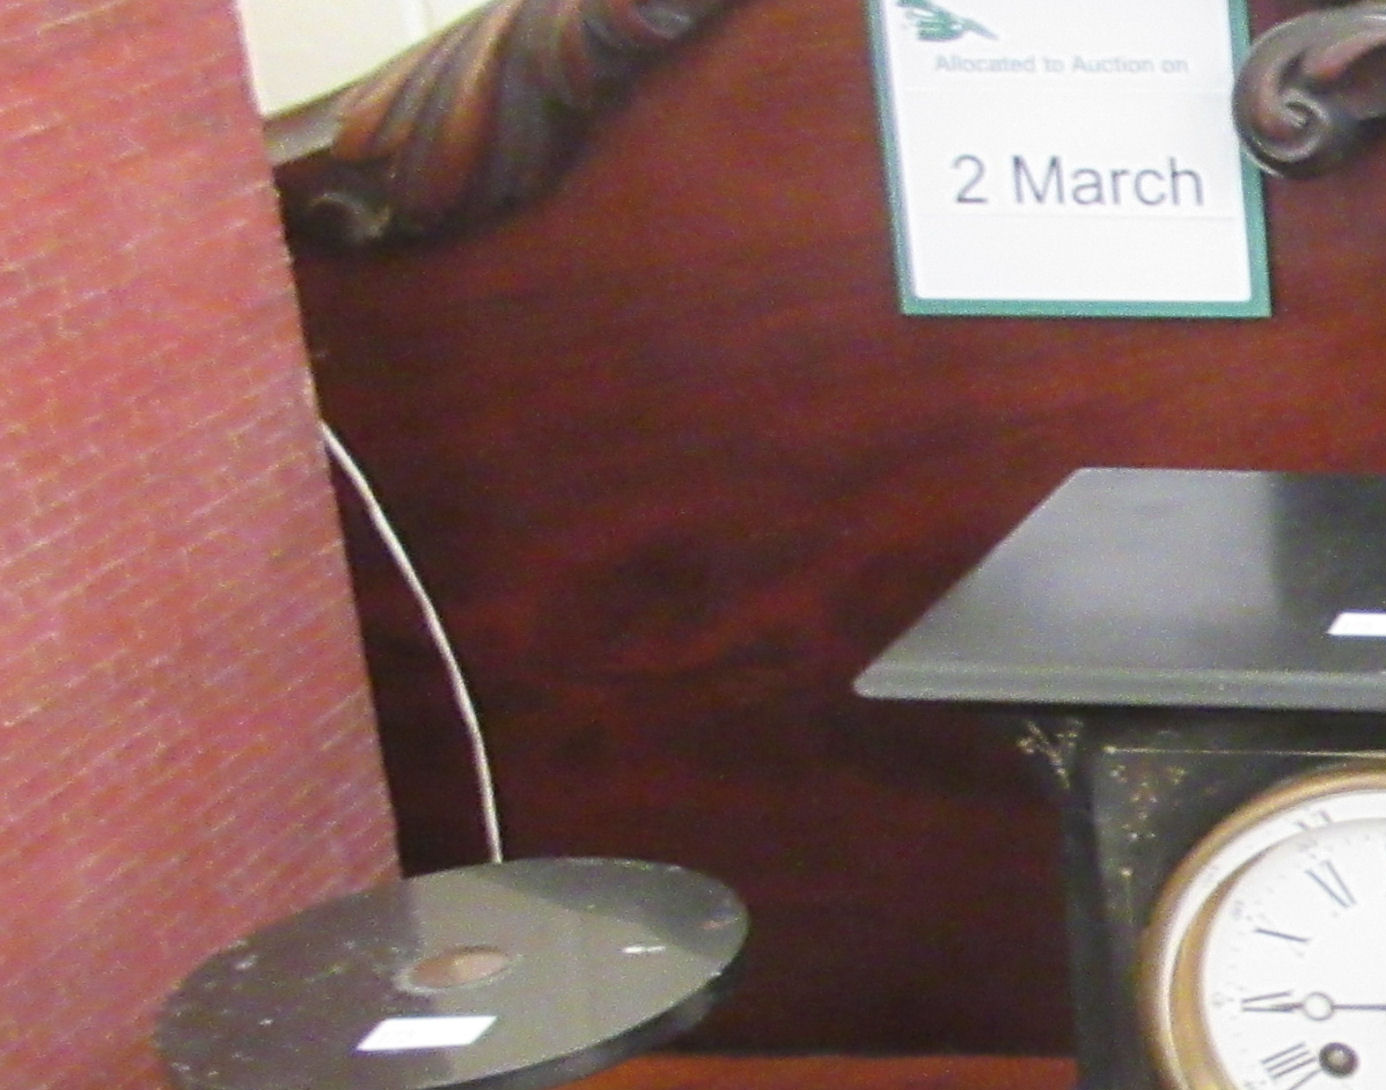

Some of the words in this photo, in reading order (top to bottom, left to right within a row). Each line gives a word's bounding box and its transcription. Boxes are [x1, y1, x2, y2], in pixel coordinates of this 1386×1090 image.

[934, 54, 1036, 74] Allocated
[1042, 55, 1064, 74] to
[1071, 54, 1155, 74] Auction
[1160, 58, 1190, 74] on
[950, 153, 989, 205] 2
[1010, 154, 1205, 207] March
